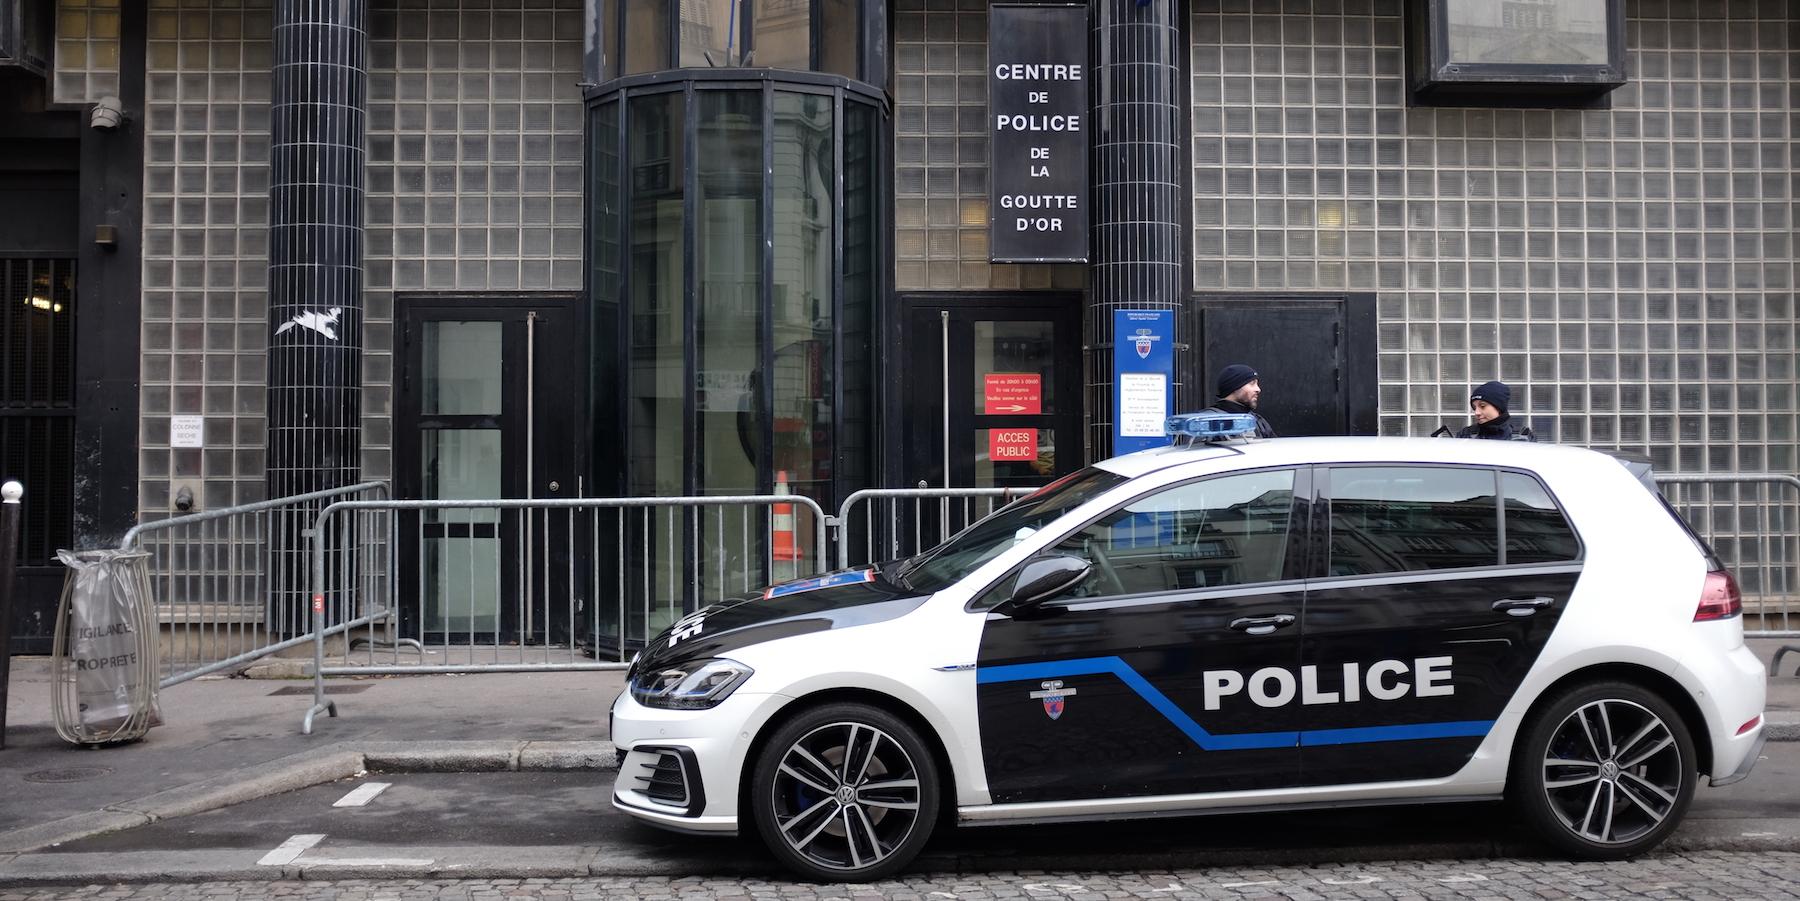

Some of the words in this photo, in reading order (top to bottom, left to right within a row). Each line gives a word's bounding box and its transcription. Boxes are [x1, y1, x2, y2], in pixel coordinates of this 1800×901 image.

[995, 64, 1082, 80] CENTRE
[1028, 92, 1049, 104] DE
[997, 115, 1080, 131] POLICE
[1030, 147, 1050, 159] DE
[1030, 165, 1050, 177] LA
[1000, 195, 1077, 209] GOUTTE
[1016, 217, 1063, 231] D'OR
[997, 432, 1030, 443] ACCES
[996, 446, 1031, 457] PUBLIC
[78, 623, 132, 639] IGILANCE
[1202, 655, 1455, 711] POLICE
